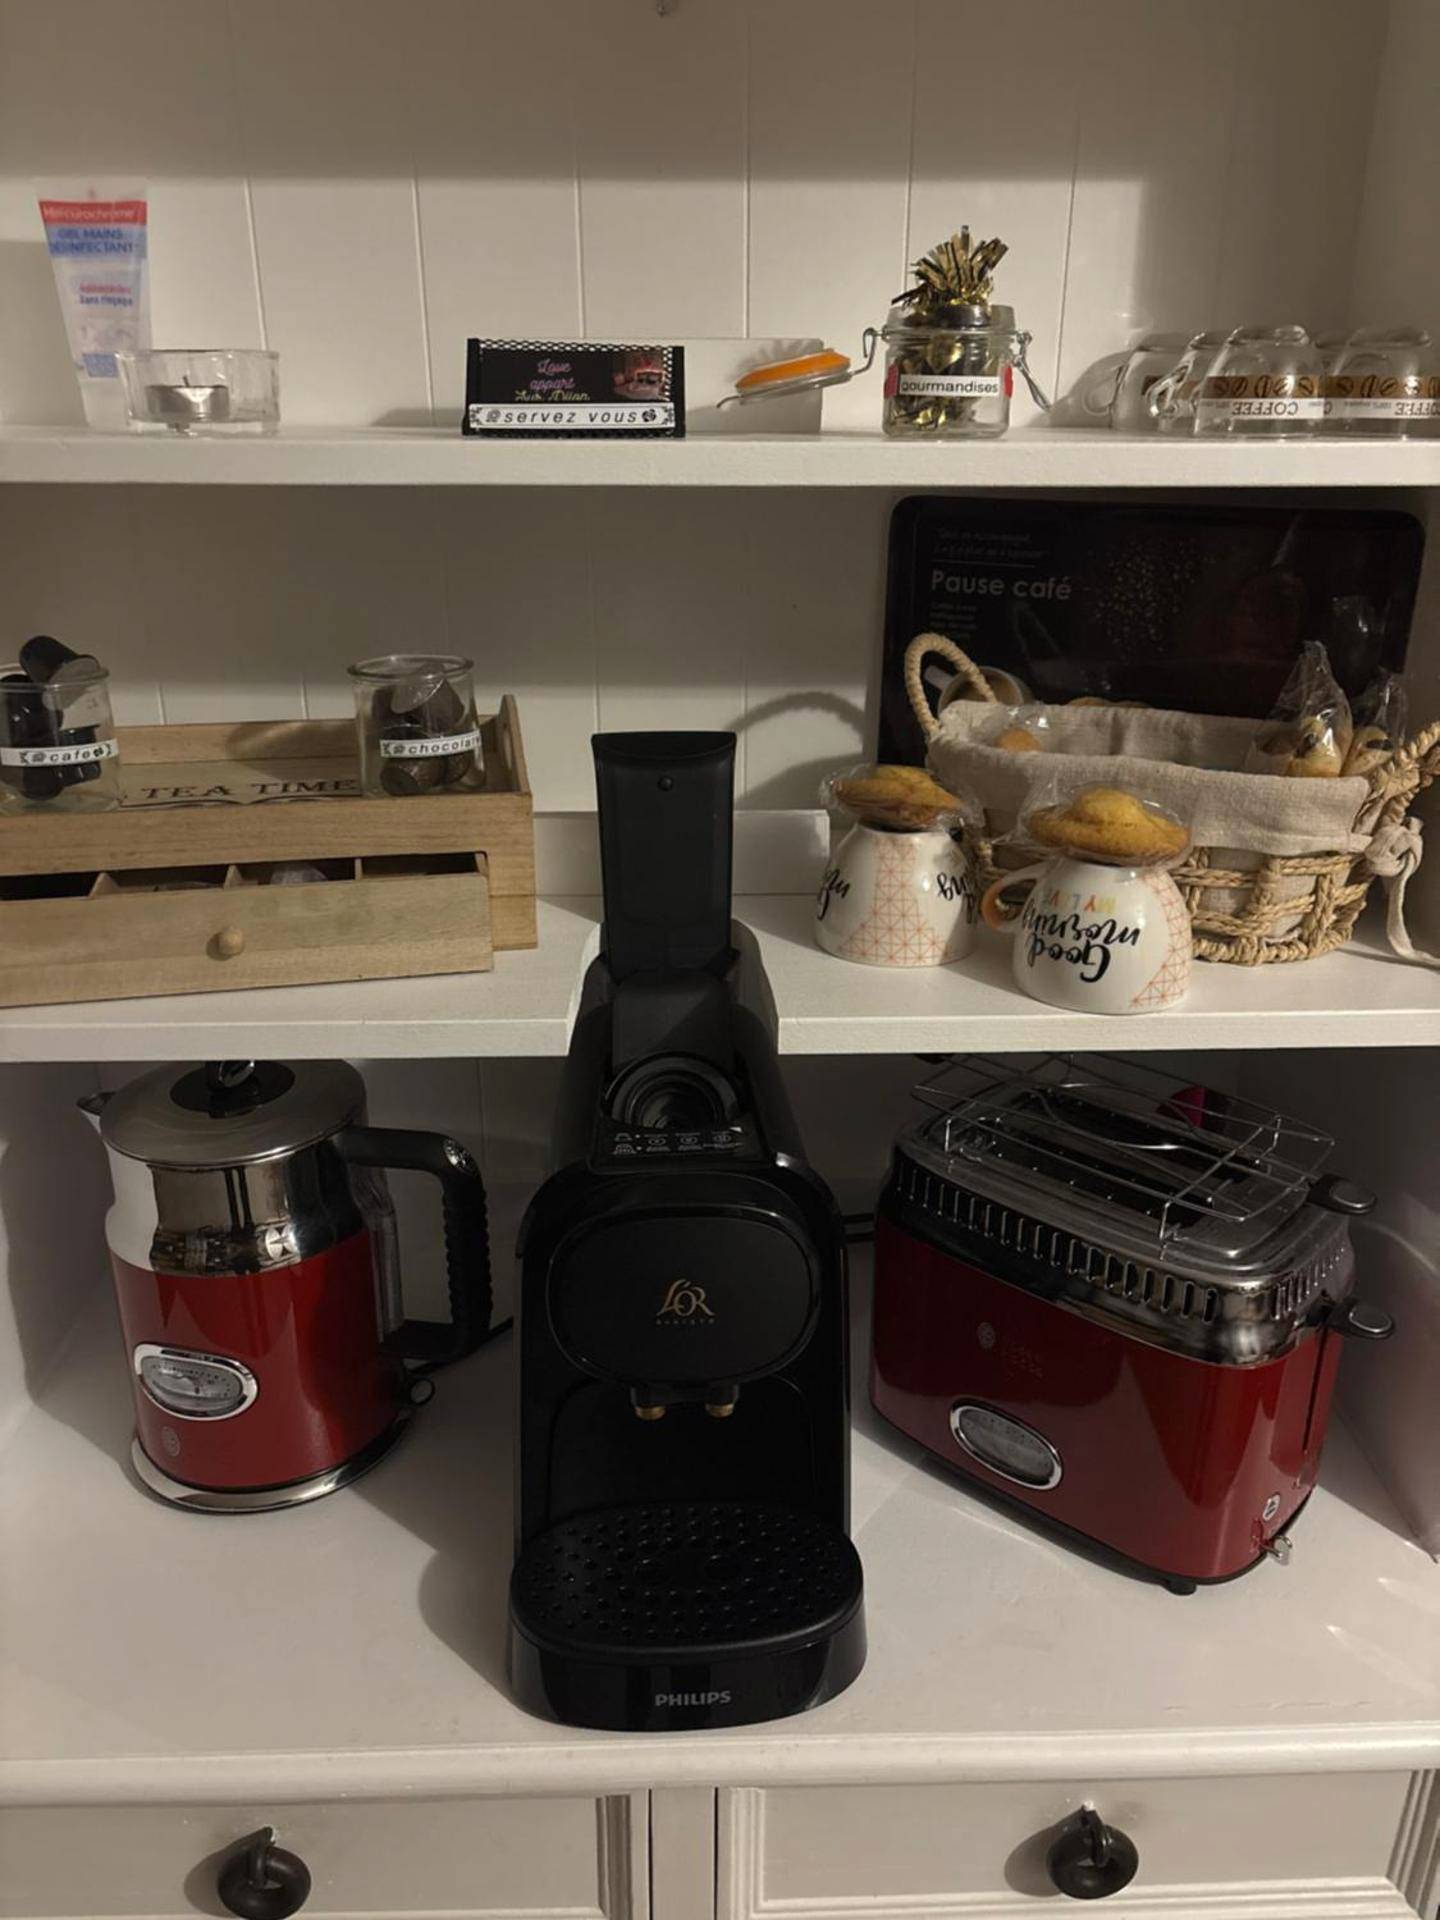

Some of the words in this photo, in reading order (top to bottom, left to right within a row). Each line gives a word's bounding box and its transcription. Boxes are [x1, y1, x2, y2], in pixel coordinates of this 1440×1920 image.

[83, 228, 123, 240] MAINS
[901, 381, 999, 394] gourmandises
[503, 410, 577, 424] servez
[588, 409, 638, 424] vous
[1231, 401, 1299, 416] COFFEE
[930, 567, 1005, 596] Pause
[1012, 575, 1073, 601] café
[141, 785, 239, 799] TEA
[251, 779, 357, 795] TIME
[1027, 933, 1112, 984] Good
[654, 1690, 732, 1707] PHILIPS
